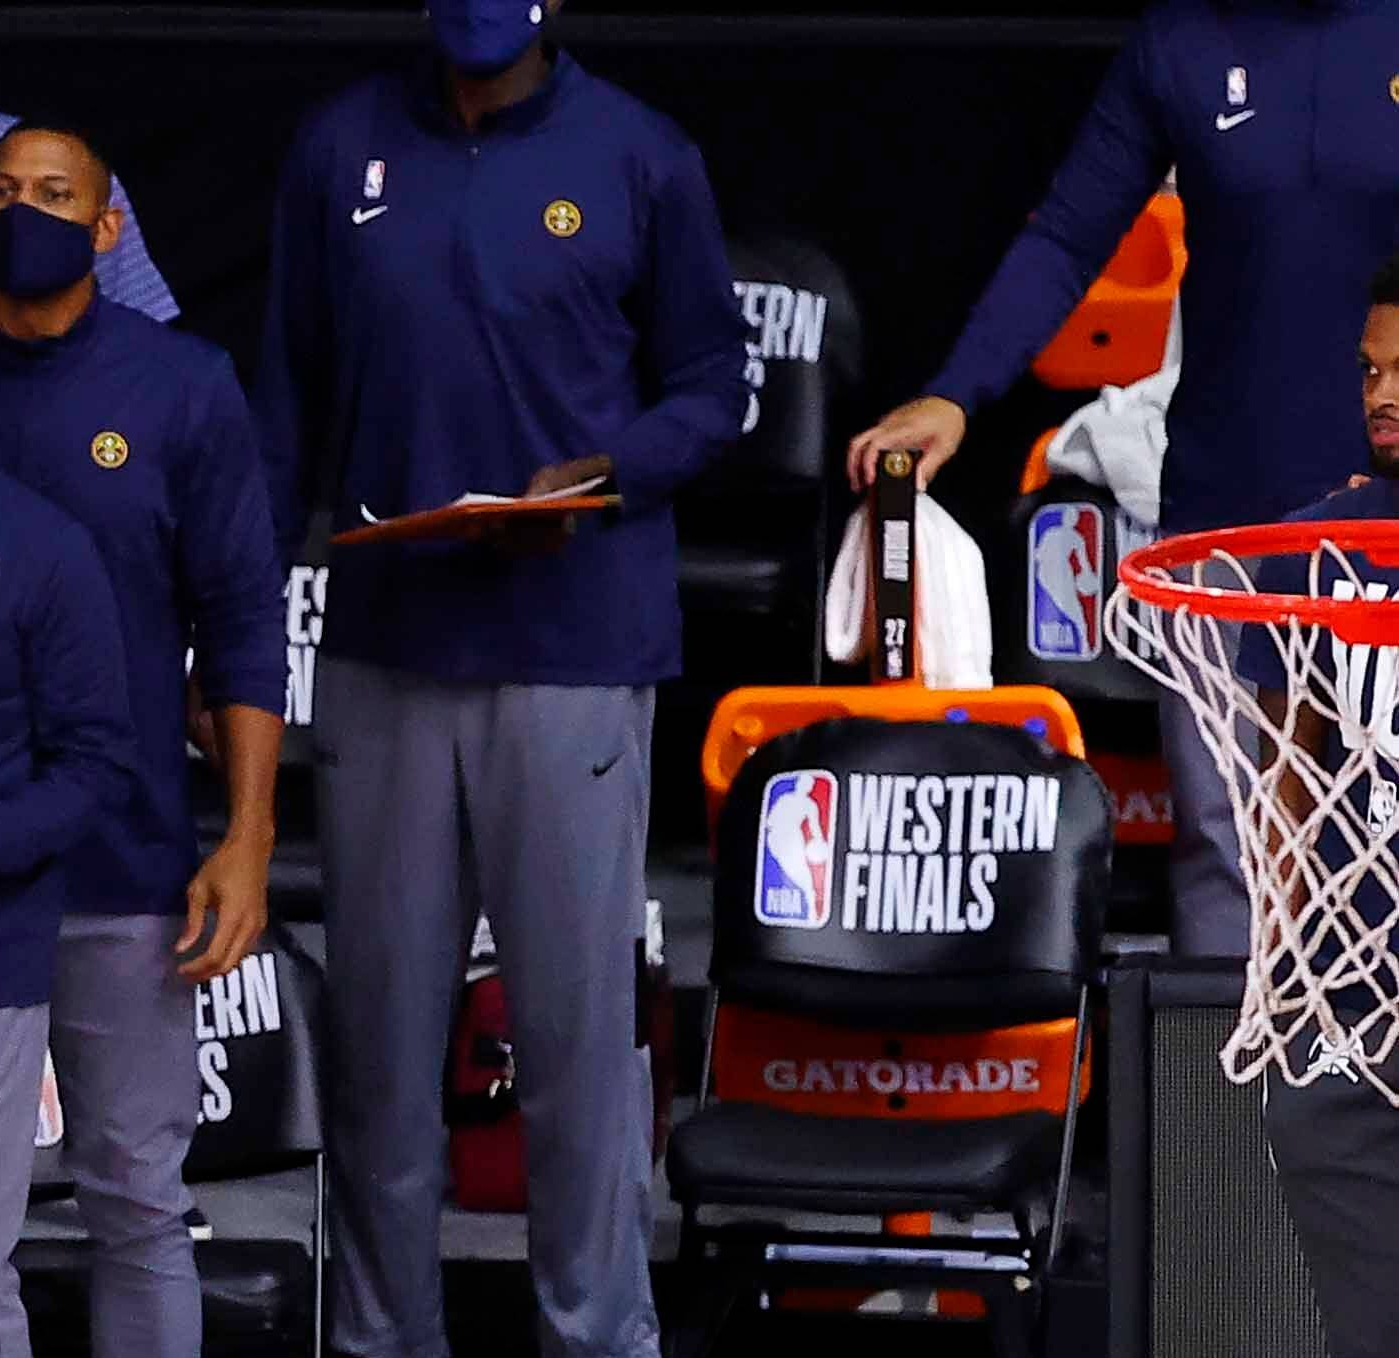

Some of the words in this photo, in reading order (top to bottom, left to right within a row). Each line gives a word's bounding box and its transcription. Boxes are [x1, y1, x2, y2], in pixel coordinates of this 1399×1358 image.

[848, 773, 1060, 854] WESTERN
[841, 851, 998, 934] FINALS
[762, 1057, 1040, 1093] GATORADE
